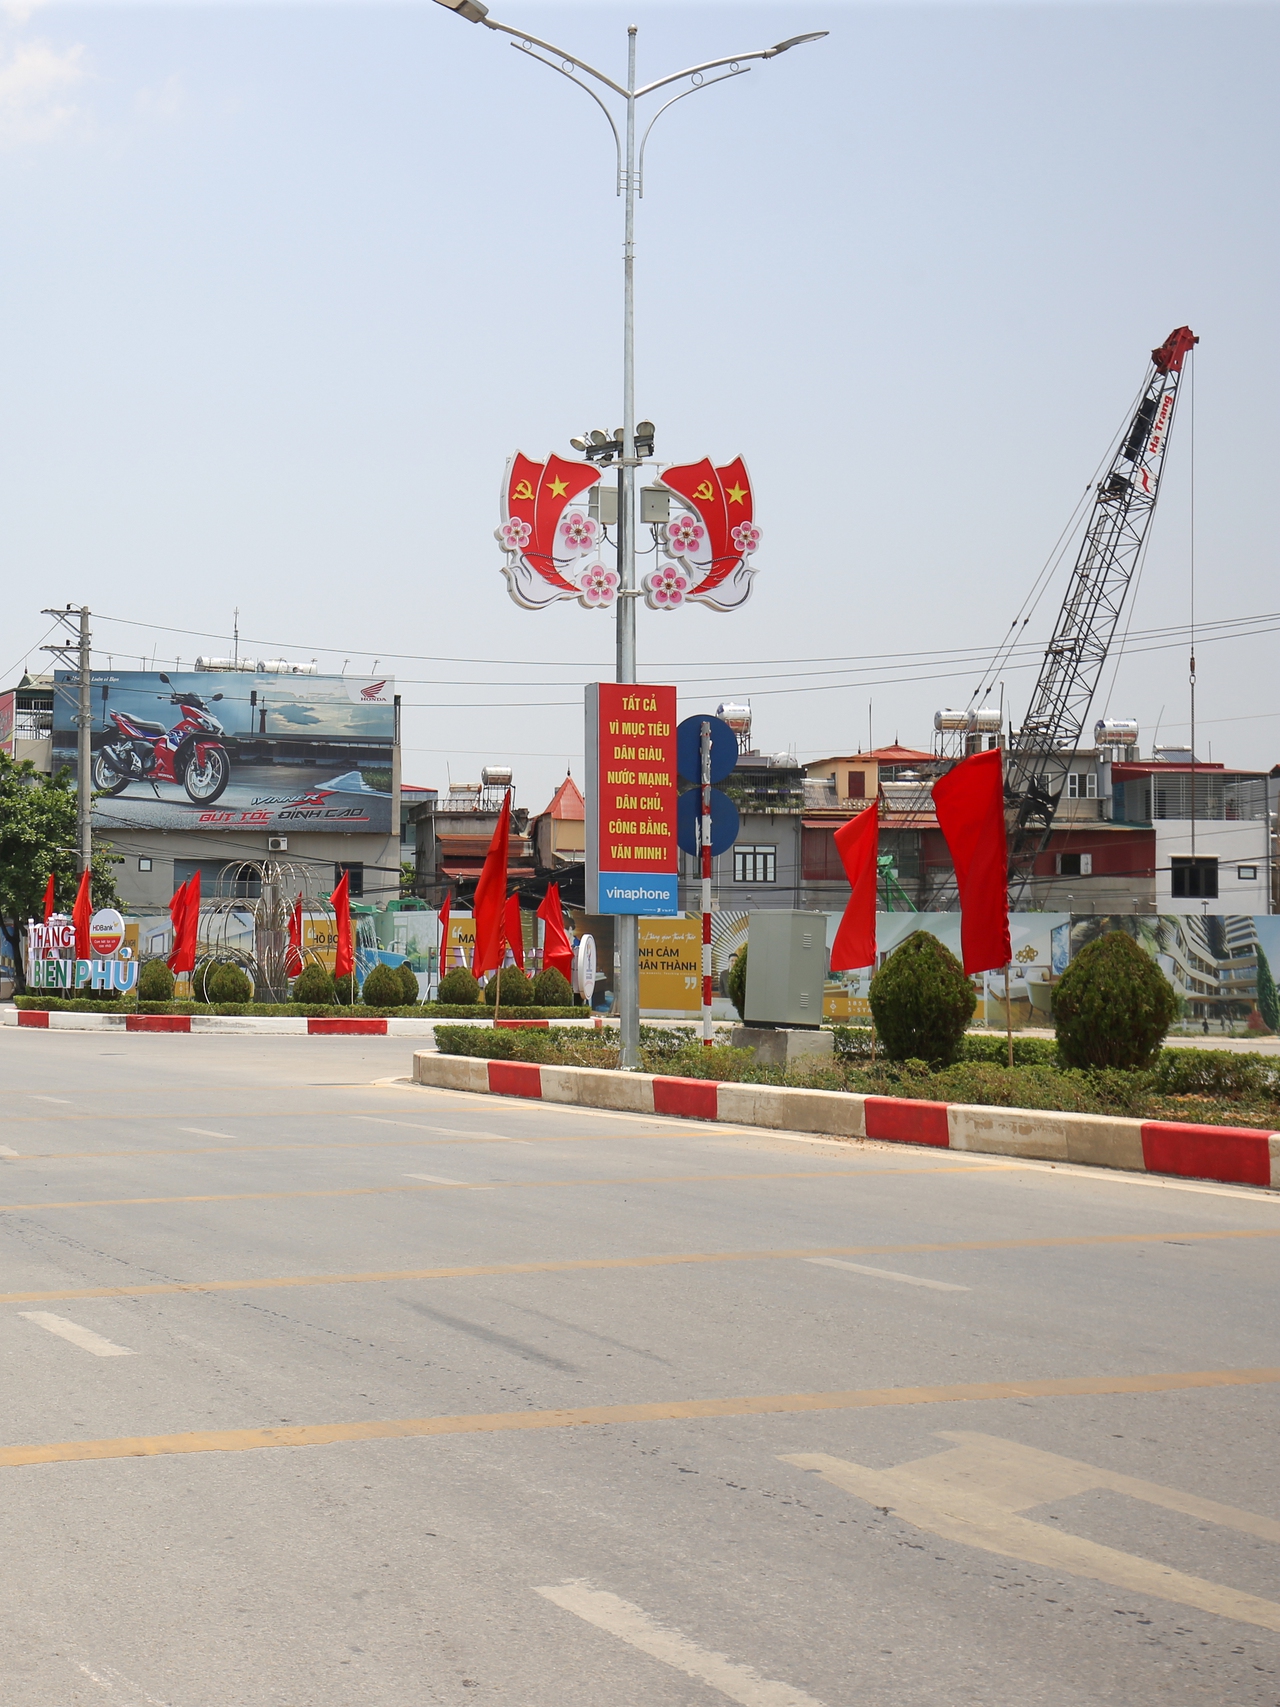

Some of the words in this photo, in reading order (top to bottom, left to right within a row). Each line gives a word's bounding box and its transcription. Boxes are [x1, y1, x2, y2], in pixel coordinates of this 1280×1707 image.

[622, 693, 640, 711] TẤT
[642, 694, 657, 712] CẢ
[609, 719, 620, 735] VÌ
[622, 722, 645, 739] MỤC
[648, 721, 670, 737] TIÊU
[614, 744, 636, 760] DÂN
[638, 745, 666, 763] GIÀU,
[607, 768, 636, 785] NƯỚC
[638, 771, 672, 789] MẠNH,
[616, 793, 638, 810] DÂN
[640, 793, 664, 812] CHỦ,
[241, 808, 276, 820] TỐC
[324, 808, 364, 818] CAO
[609, 818, 637, 835] CÔNG
[639, 816, 671, 837] BẰNG,
[611, 844, 632, 859] VĂN
[606, 886, 670, 901] vinaphone
[638, 948, 654, 957] NH
[656, 946, 679, 957] CẢM
[638, 959, 658, 970] HÂN
[660, 960, 697, 971] THÀNH
